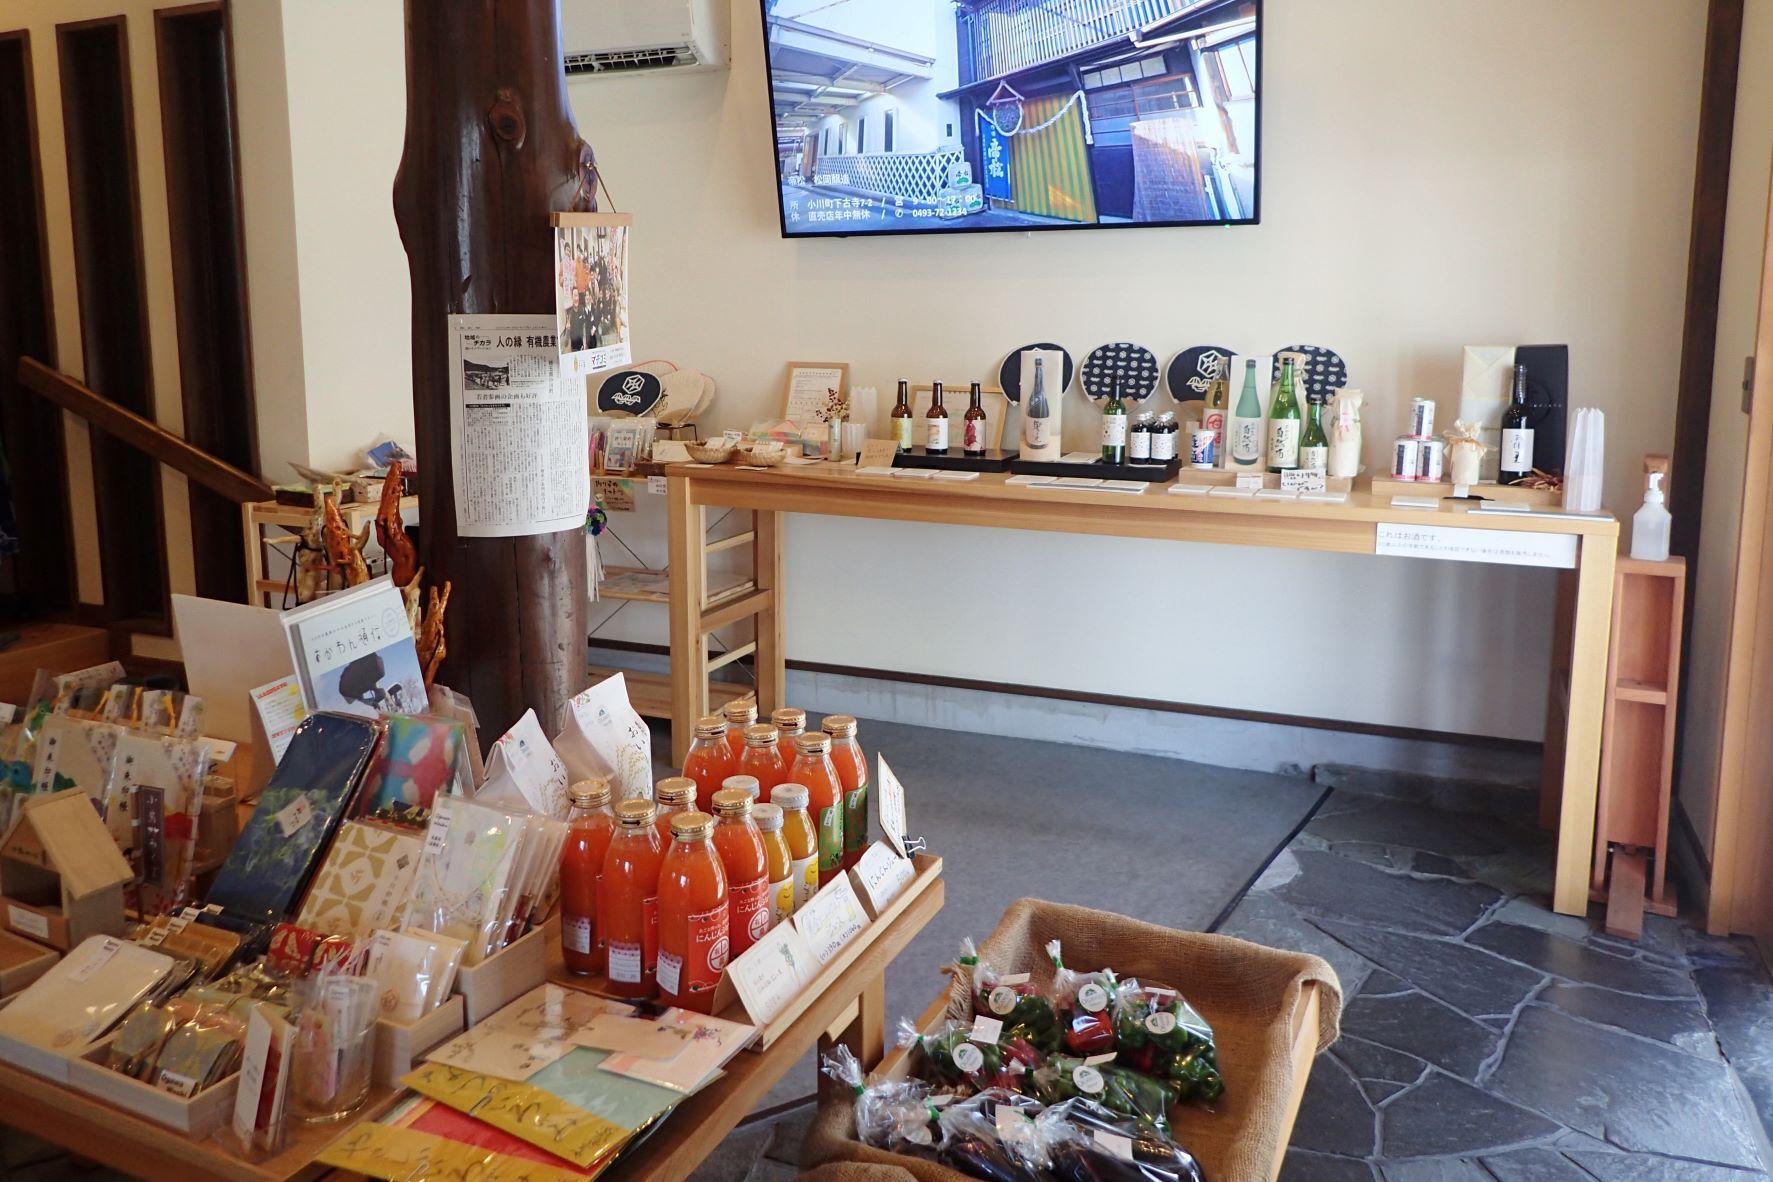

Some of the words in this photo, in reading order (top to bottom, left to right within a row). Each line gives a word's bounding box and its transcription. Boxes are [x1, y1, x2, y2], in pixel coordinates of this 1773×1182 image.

[808, 209, 871, 221] 直売店年中無休
[496, 335, 522, 348] 人の縁
[526, 336, 558, 348] 有機農業
